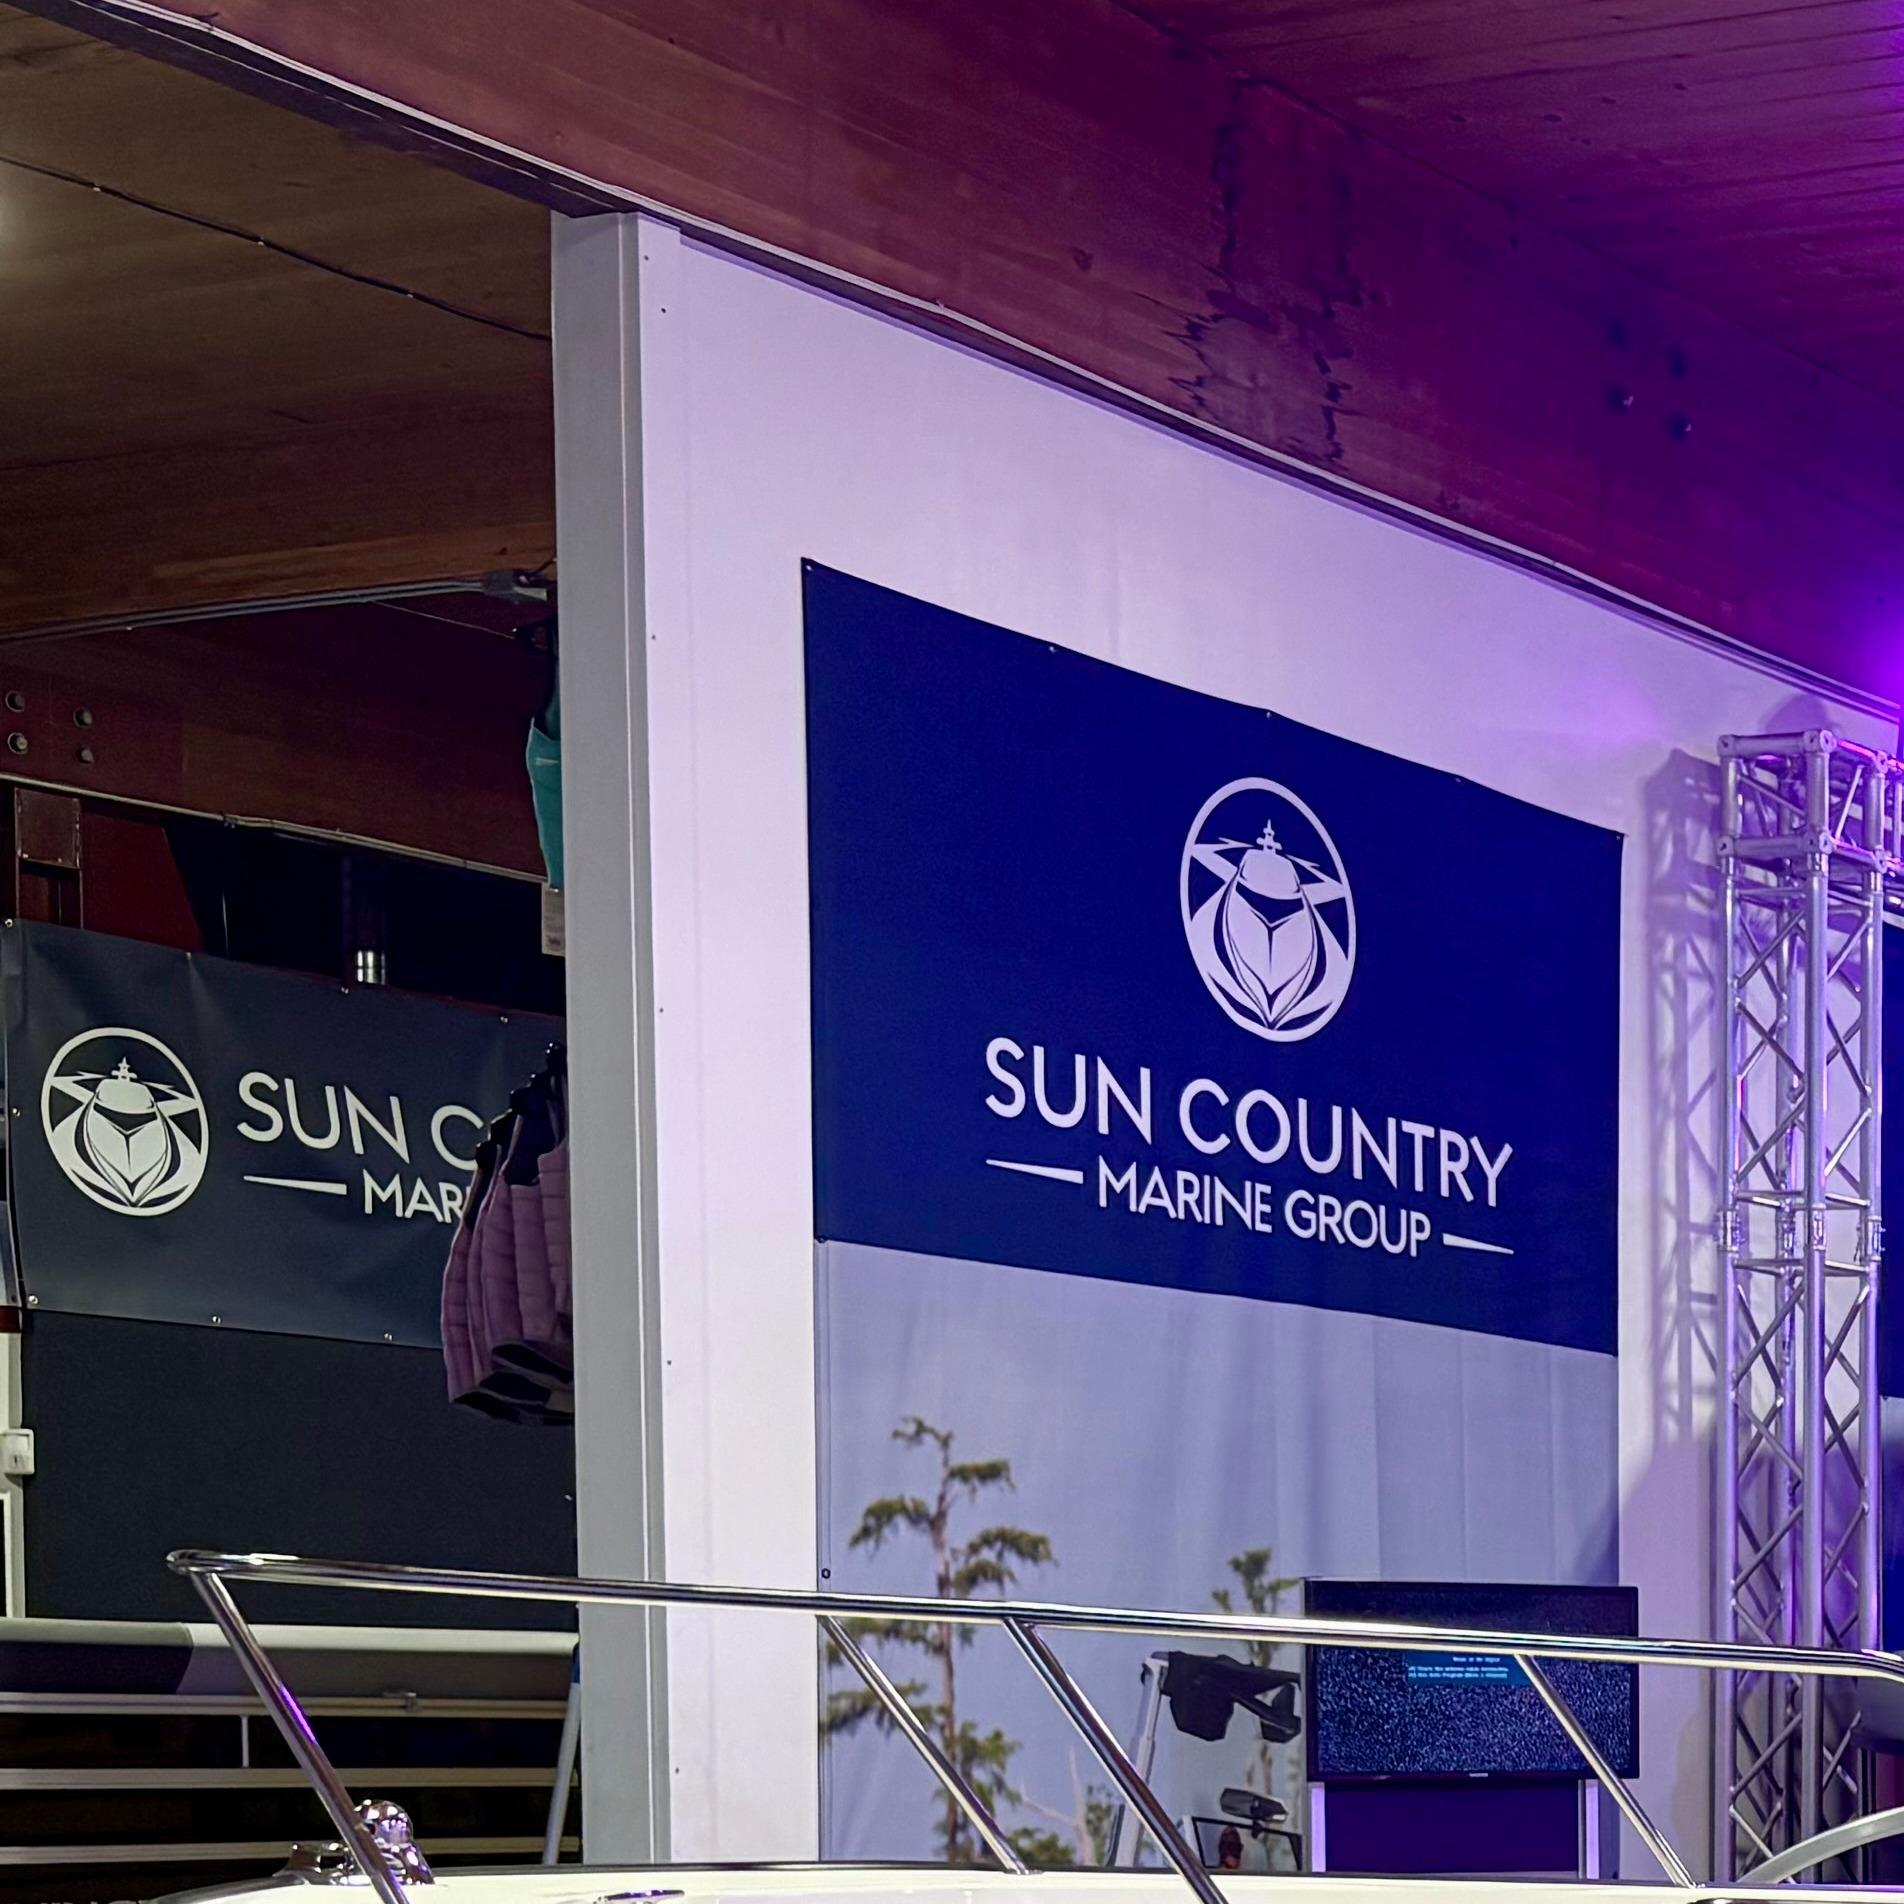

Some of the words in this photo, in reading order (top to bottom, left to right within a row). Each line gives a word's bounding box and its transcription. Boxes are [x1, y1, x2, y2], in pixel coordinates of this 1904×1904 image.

[236, 1071, 410, 1164] SUN
[985, 1037, 1152, 1145] SUN
[1178, 1078, 1514, 1207] COUNTRY
[362, 1168, 471, 1224] MAR
[1098, 1154, 1273, 1234] MARINE
[1284, 1189, 1431, 1258] GROUP
